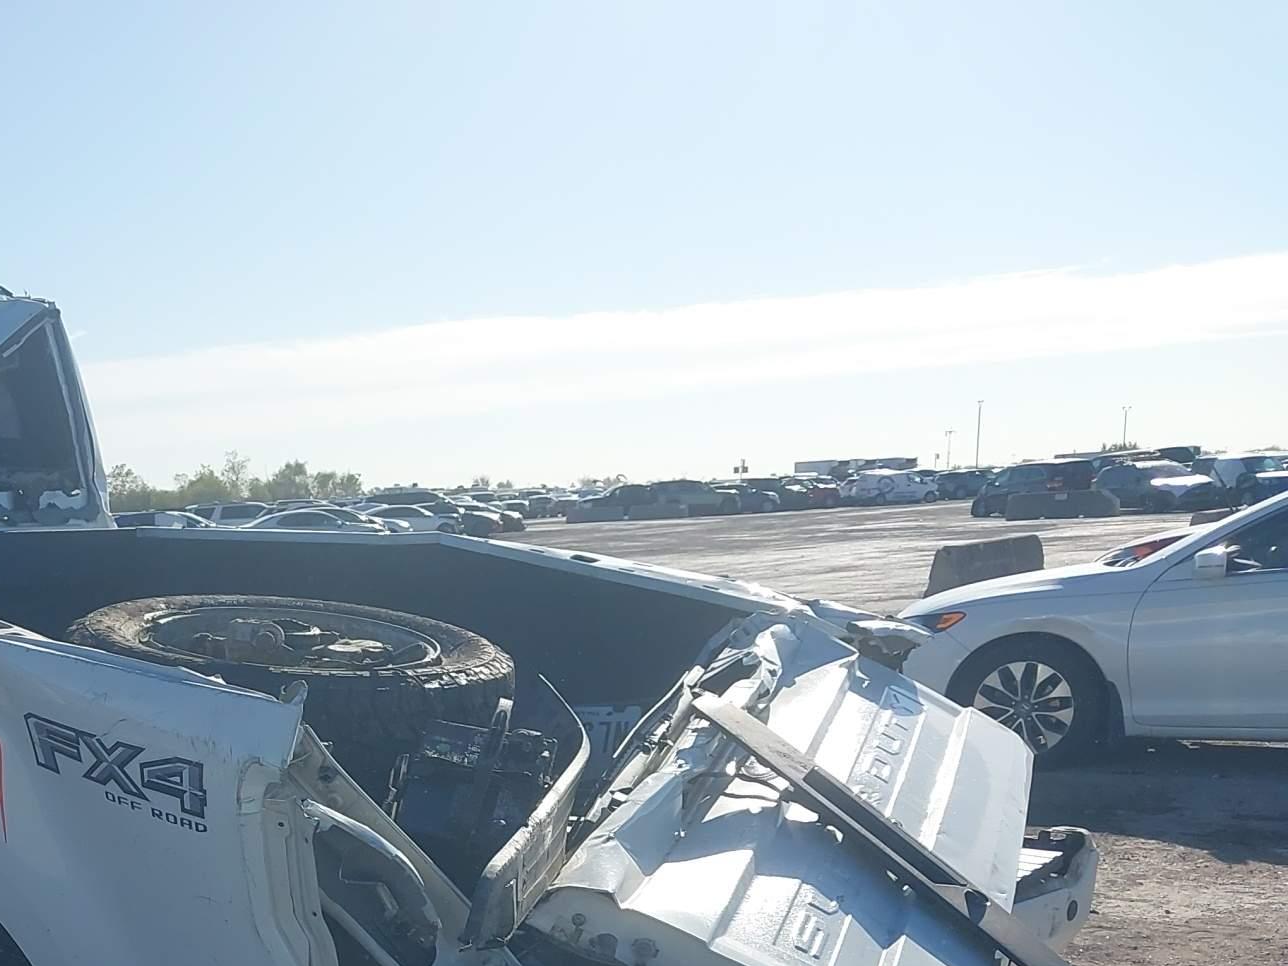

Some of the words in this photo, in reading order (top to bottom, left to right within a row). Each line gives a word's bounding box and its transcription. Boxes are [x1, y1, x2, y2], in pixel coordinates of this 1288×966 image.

[24, 712, 208, 819] FX4
[105, 791, 142, 811] OFF
[151, 807, 208, 833] ROAD
